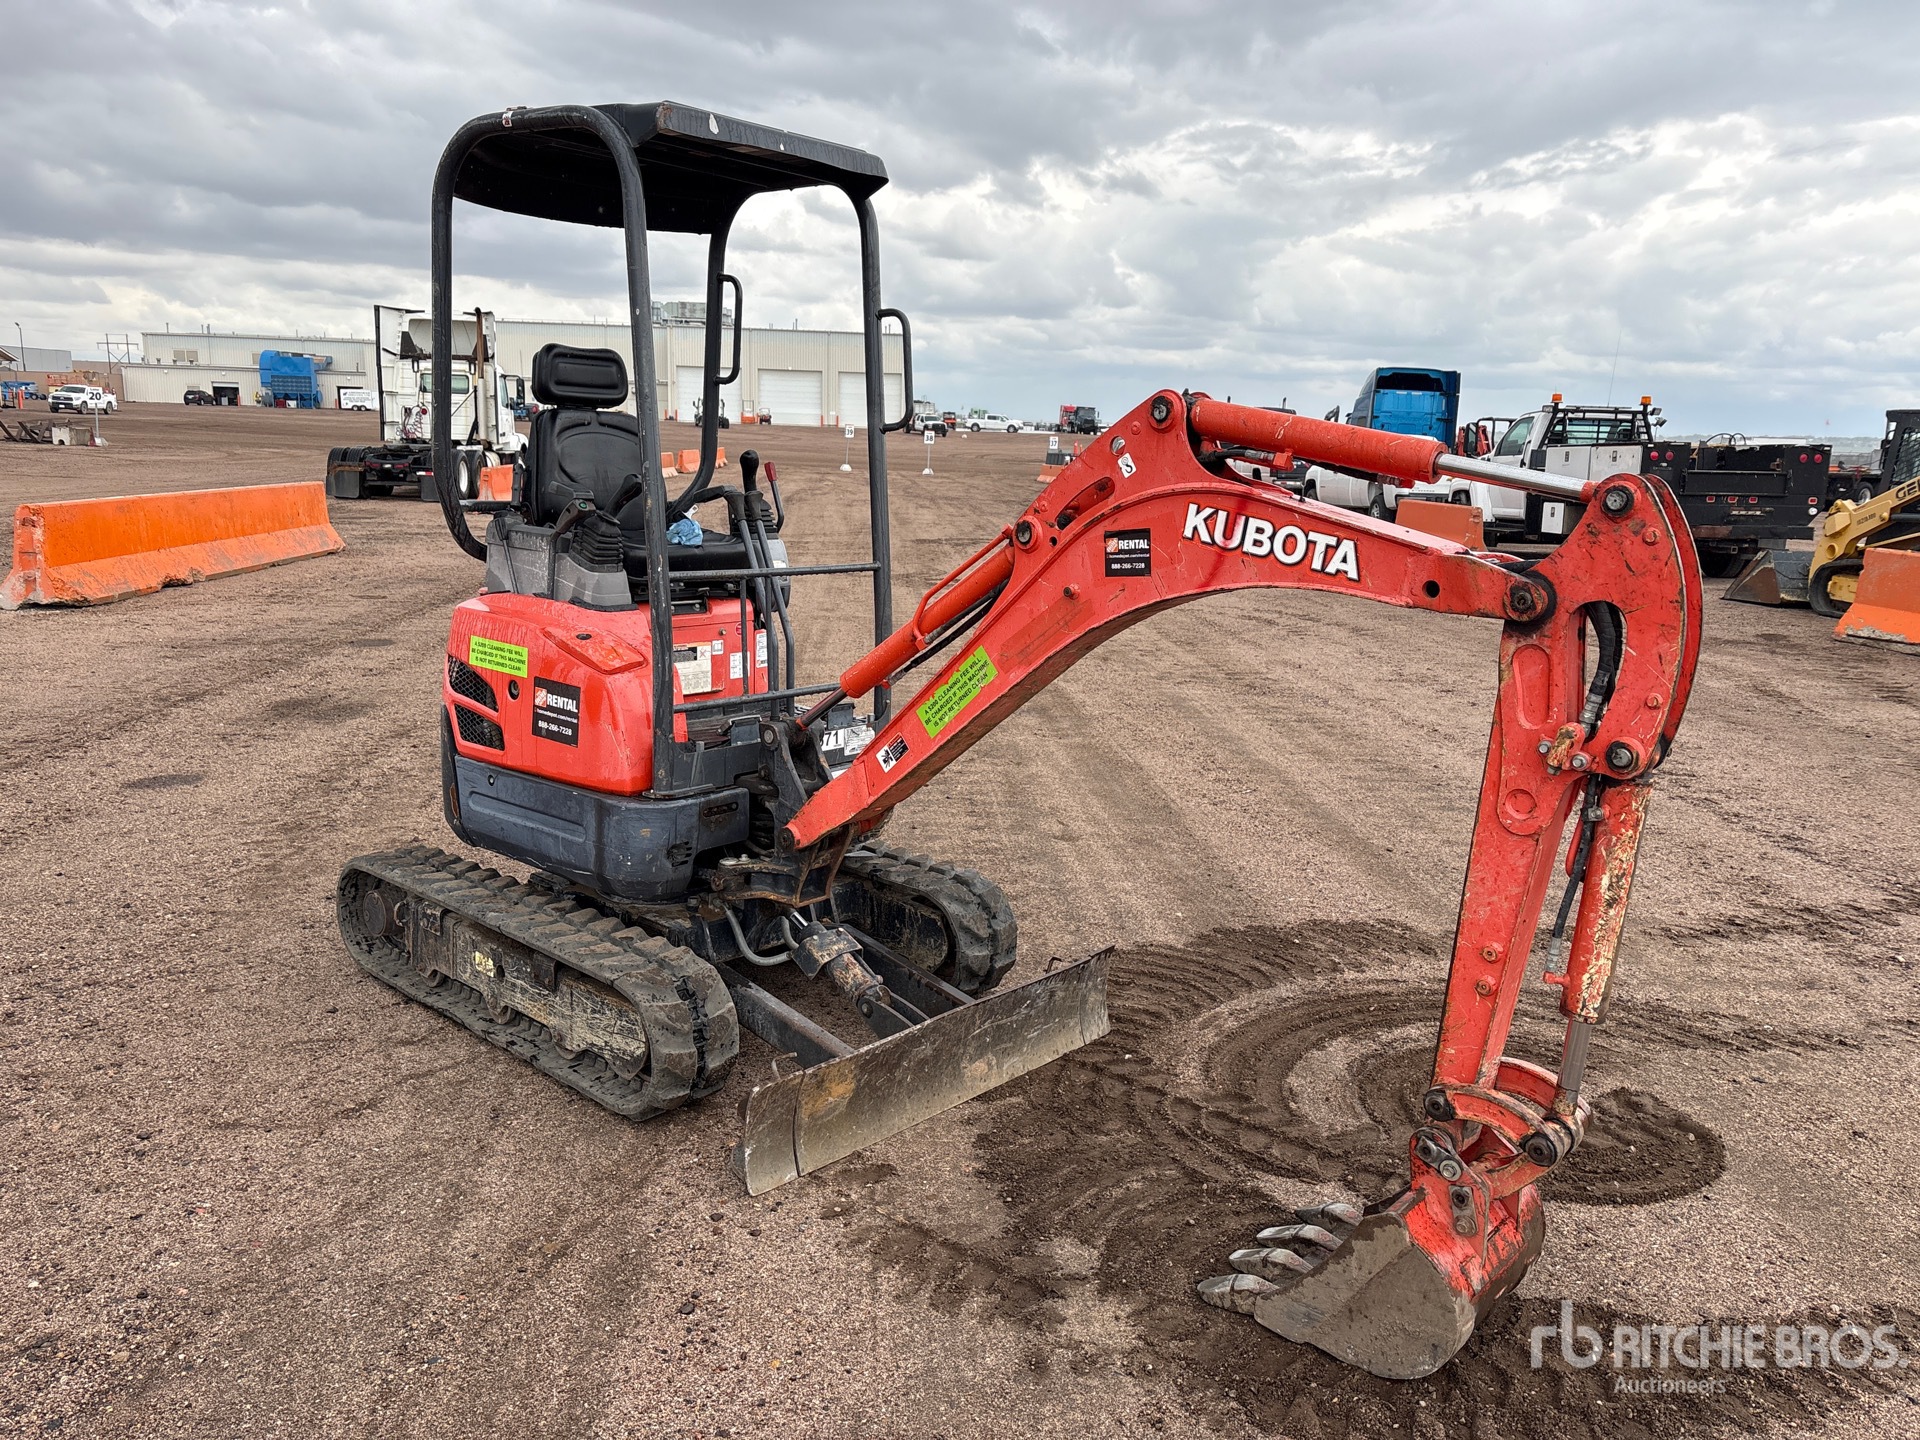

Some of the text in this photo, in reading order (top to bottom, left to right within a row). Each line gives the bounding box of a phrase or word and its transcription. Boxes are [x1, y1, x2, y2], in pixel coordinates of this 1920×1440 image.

[89, 392, 101, 400] 20
[1118, 539, 1149, 549] RENTAL
[1182, 502, 1360, 581] KUBOTA
[487, 644, 506, 653] CLEANING
[477, 649, 494, 658] CHARGED
[508, 656, 526, 665] MACHINE
[488, 659, 507, 668] RETURNED
[928, 699, 938, 710] $200
[938, 677, 960, 702] CLEANING
[960, 668, 970, 680] FEE
[969, 658, 981, 669] WILL
[924, 717, 931, 725] BE
[931, 696, 953, 719] CHARGED
[957, 681, 968, 693] THIS
[967, 660, 990, 683] MACHINE
[938, 710, 949, 722] NOT
[947, 687, 973, 712] RETURNED
[972, 673, 988, 690] CLEAN
[547, 693, 578, 713] RENTAL
[538, 720, 572, 736] 888-266-7228
[820, 730, 838, 746] 71
